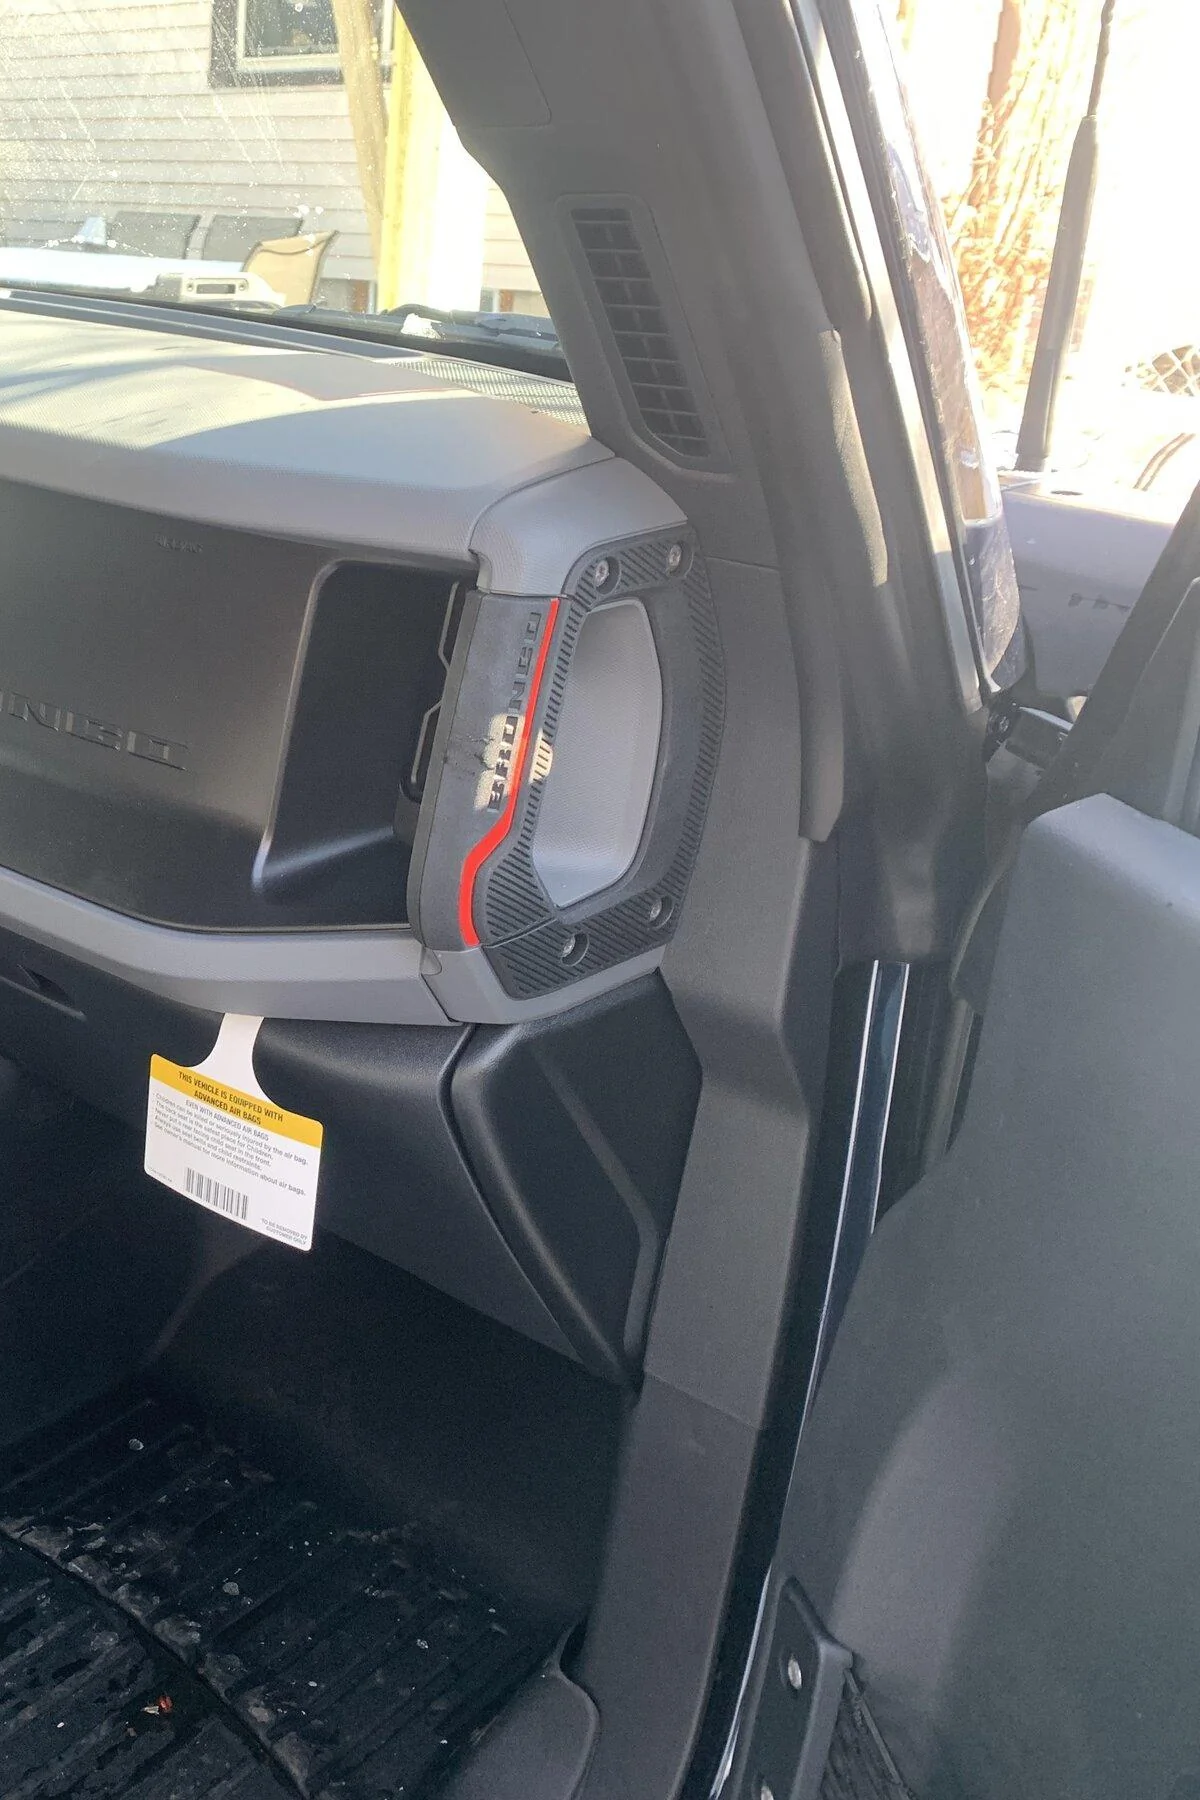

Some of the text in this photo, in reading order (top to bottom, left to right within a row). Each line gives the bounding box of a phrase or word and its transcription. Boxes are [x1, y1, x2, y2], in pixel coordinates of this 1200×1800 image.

[179, 1071, 283, 1122] THIS VEHICLE IS EQUIPPED WITH
[194, 1091, 261, 1125] ADVANCED AIR BAGS
[186, 1100, 268, 1141] EVEN WITH ADVANCED AIR BAGS
